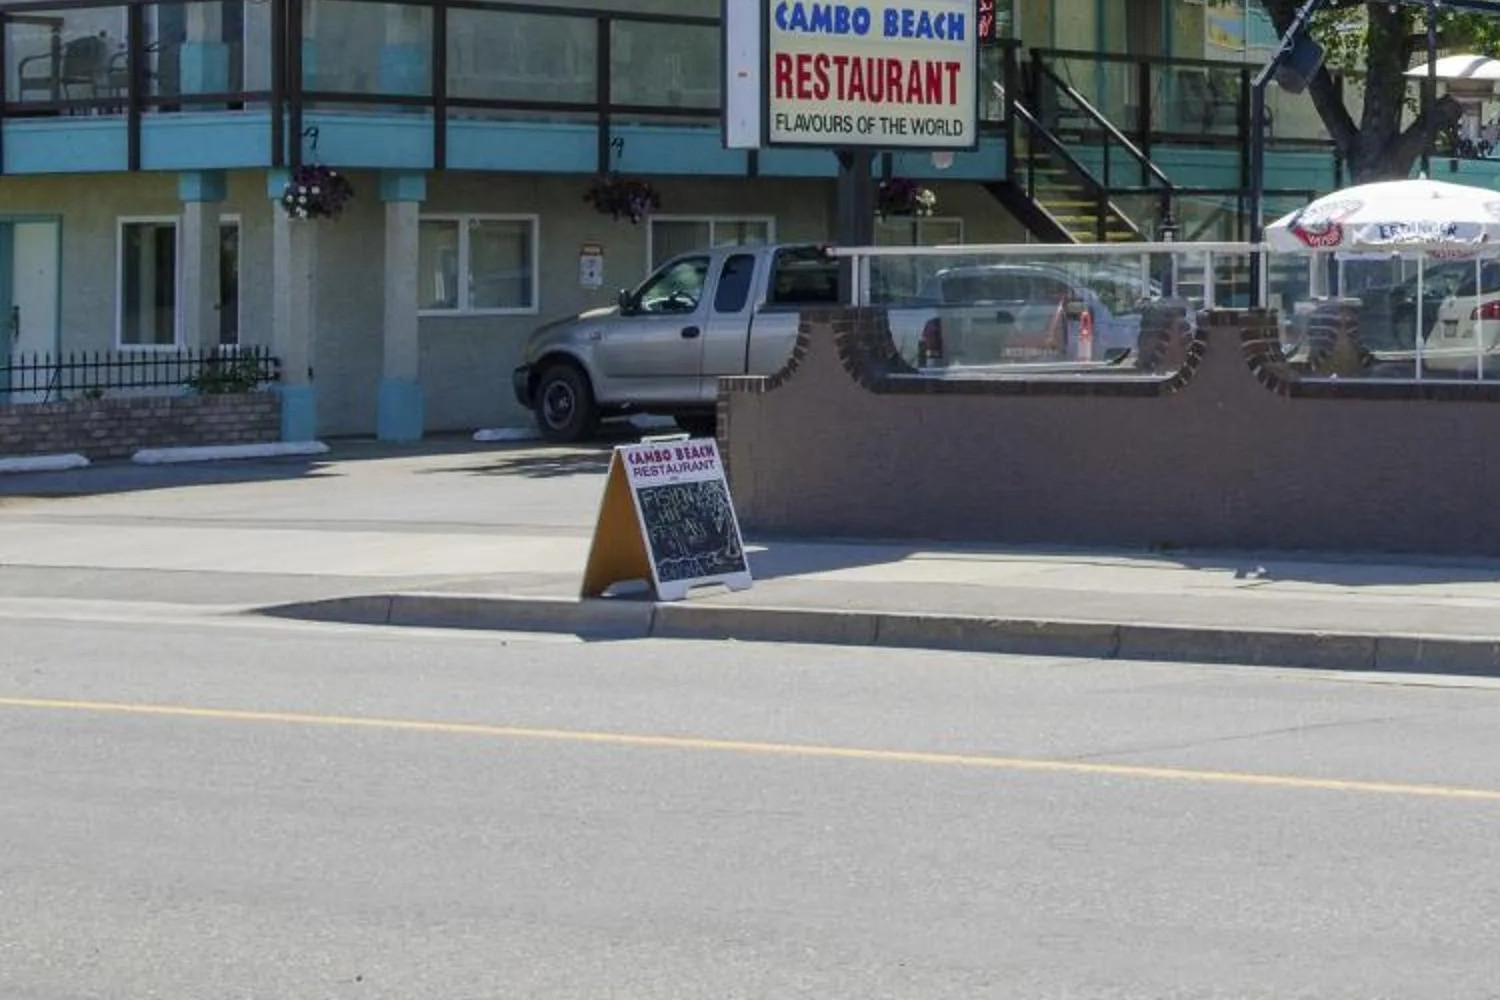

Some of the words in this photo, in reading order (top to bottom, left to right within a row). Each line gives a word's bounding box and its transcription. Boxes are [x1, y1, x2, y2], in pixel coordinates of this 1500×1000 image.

[775, 2, 871, 36] CAMBO
[883, 8, 965, 42] BEACH
[775, 53, 961, 106] RESTAURANT
[775, 113, 854, 134] FLAVOURS
[857, 118, 876, 134] OF
[881, 118, 907, 136] THE
[911, 119, 963, 138] WORLD
[628, 449, 672, 465] CAMBO
[675, 445, 715, 460] BEACH
[633, 459, 716, 478] RESTAURANT
